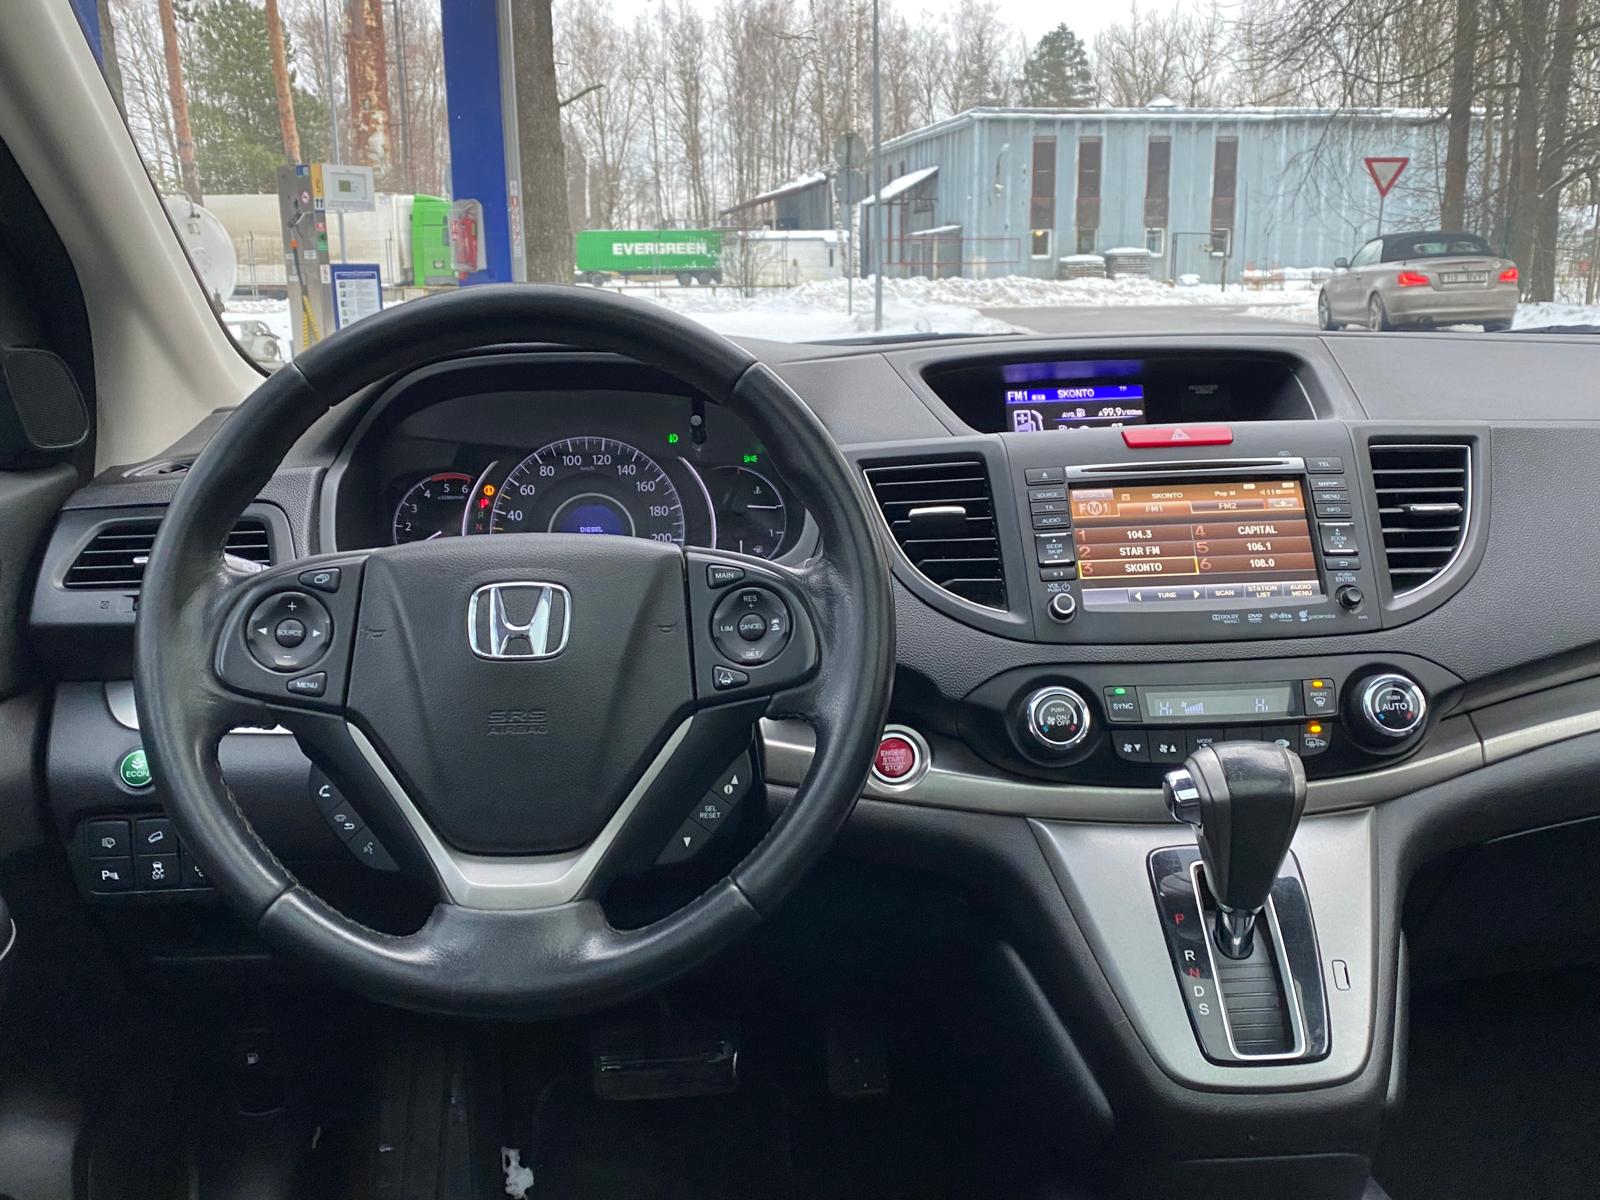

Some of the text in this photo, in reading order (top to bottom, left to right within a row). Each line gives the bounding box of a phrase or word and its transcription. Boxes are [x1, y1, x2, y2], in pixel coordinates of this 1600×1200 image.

[612, 242, 707, 256] EVERGREEN
[1008, 391, 1028, 401] FM1
[1057, 389, 1094, 398] SKONTO
[562, 455, 581, 466] 100
[592, 454, 611, 465] 120
[539, 465, 554, 477] 80
[617, 464, 636, 475] 140
[444, 484, 450, 493] 5
[461, 484, 468, 494] 6
[520, 484, 535, 496] 60
[636, 481, 655, 492] 160
[424, 489, 431, 498] 4
[411, 504, 418, 513] 3
[649, 505, 669, 516] 180
[507, 510, 523, 521] 40
[405, 522, 411, 531] 2
[1195, 525, 1206, 536] 4
[1238, 525, 1277, 535] CAPITAL
[1079, 530, 1086, 541] 1
[1126, 530, 1152, 539] 104.3
[1080, 546, 1091, 558] 2
[1120, 546, 1160, 556] STAR FM
[1196, 541, 1208, 553] 5
[1246, 542, 1271, 551] 106.1
[1082, 563, 1093, 574] 3
[1125, 563, 1162, 573] SKONTO
[1200, 558, 1211, 570] 6
[1249, 558, 1275, 568] 108.0
[1382, 702, 1407, 711] AUTO
[488, 709, 546, 723] SRS
[126, 770, 149, 778] ECON
[1174, 913, 1184, 924] P
[1184, 949, 1196, 961] R
[1188, 967, 1200, 979] N
[1194, 985, 1204, 997] D
[1199, 1003, 1209, 1015] S
